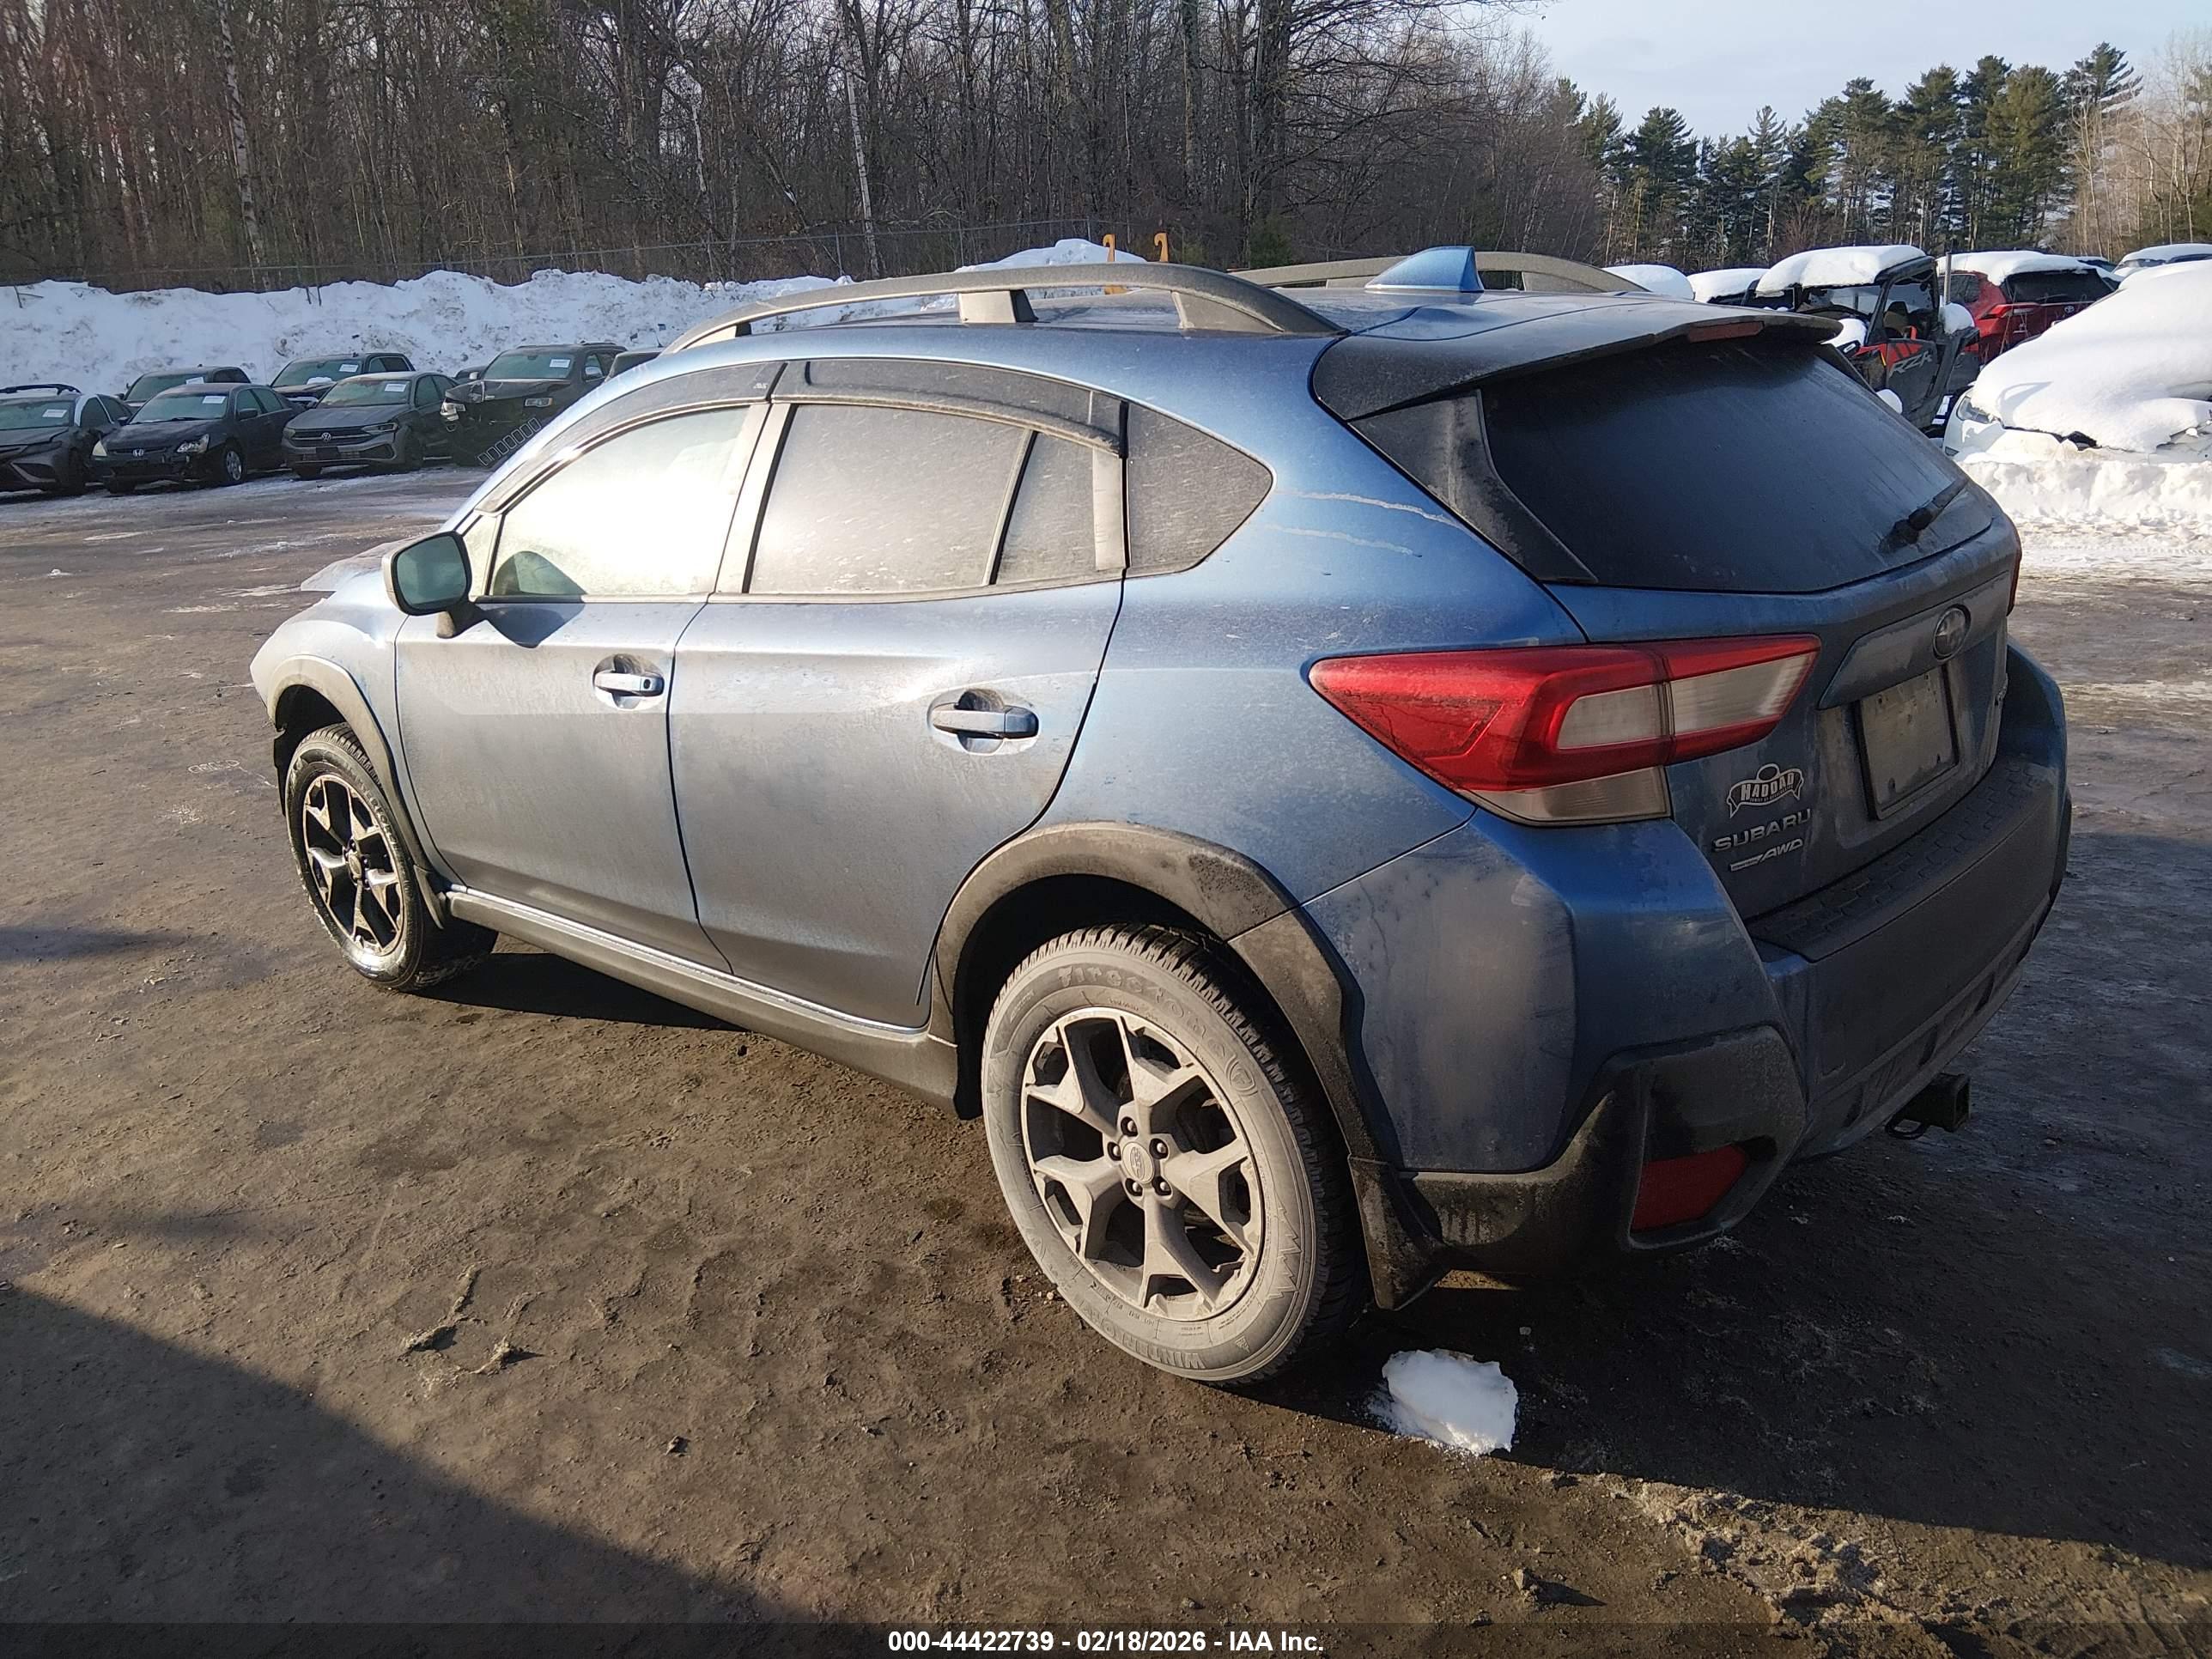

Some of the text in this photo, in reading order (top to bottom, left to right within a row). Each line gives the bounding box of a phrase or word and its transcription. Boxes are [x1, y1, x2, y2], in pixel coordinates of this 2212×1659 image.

[1741, 773, 1795, 801] HADDAD
[1714, 808, 1811, 852] SUBARU
[1759, 838, 1804, 863] AWD
